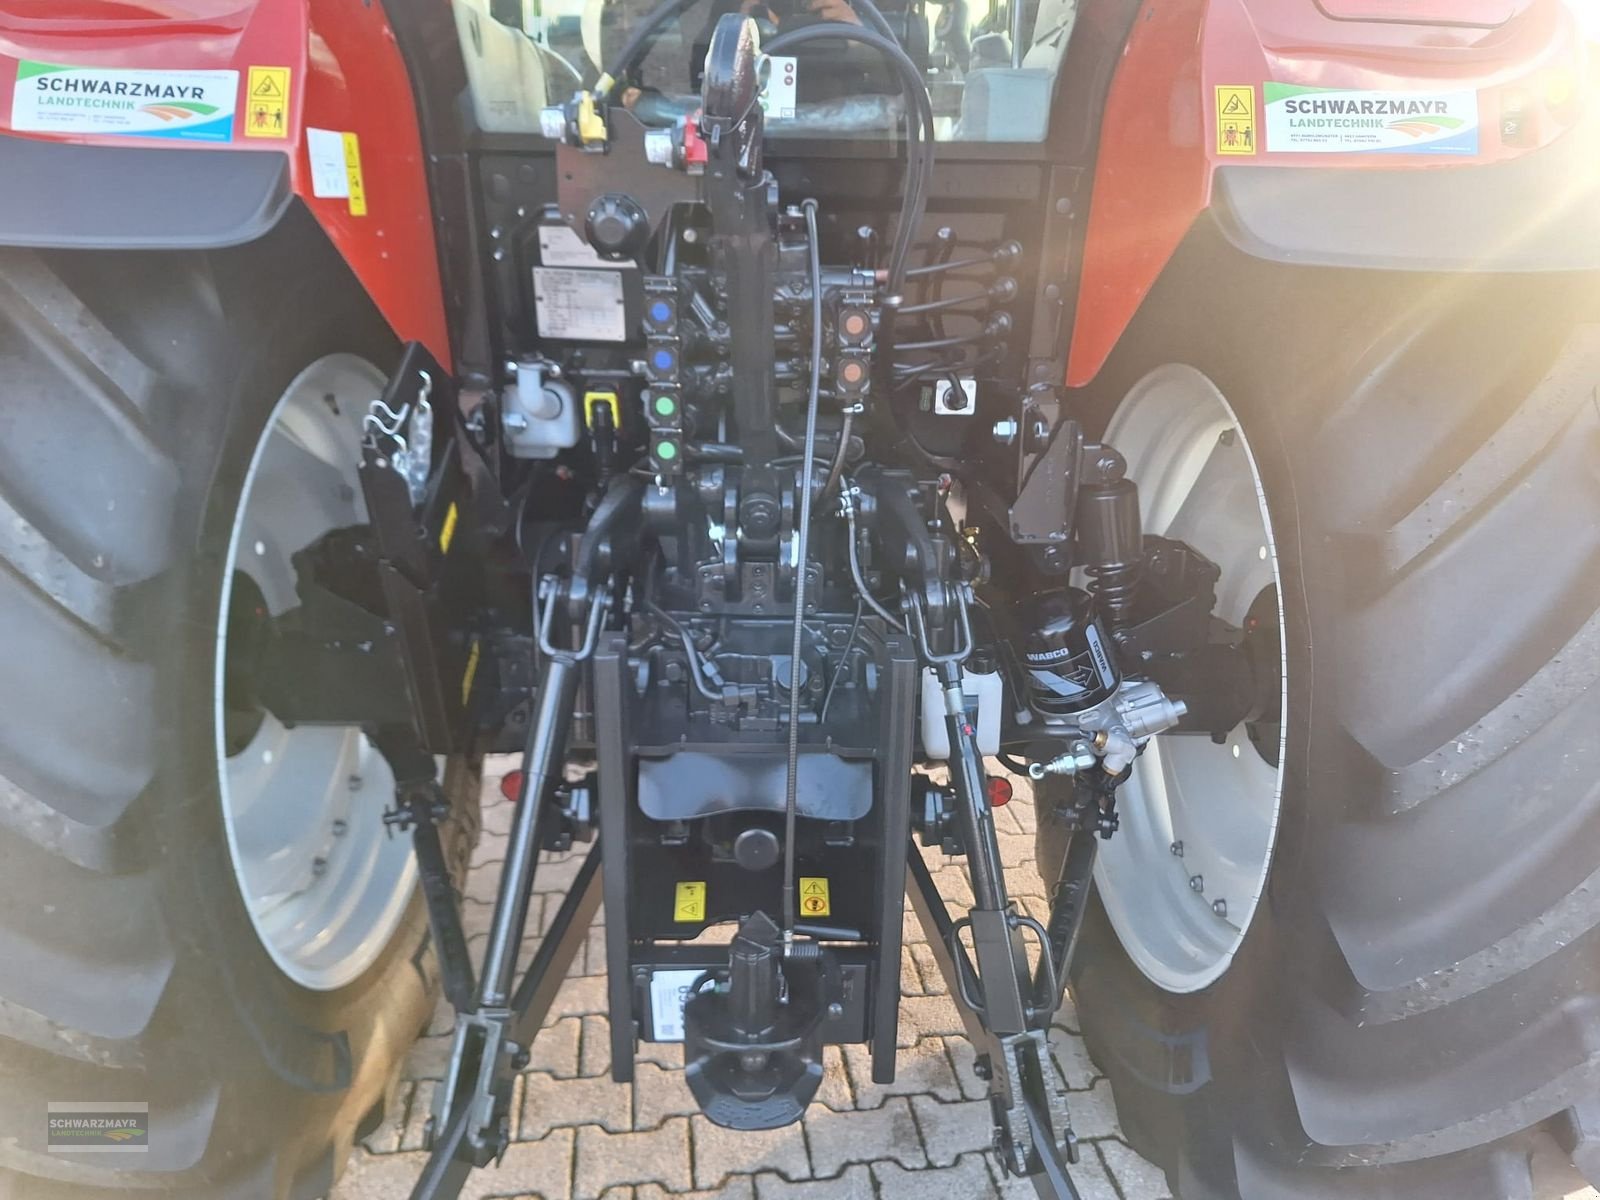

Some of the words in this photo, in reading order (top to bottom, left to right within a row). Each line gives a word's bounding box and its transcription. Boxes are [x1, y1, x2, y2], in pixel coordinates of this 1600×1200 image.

[36, 77, 205, 100] SCHWARZMAYR
[38, 96, 136, 111] LANDTECHNIK
[1285, 100, 1448, 115] SCHWARZMAYR
[1289, 118, 1385, 128] LANDTECHNIK
[1027, 647, 1069, 662] WABCO
[1093, 641, 1107, 674] WABCO
